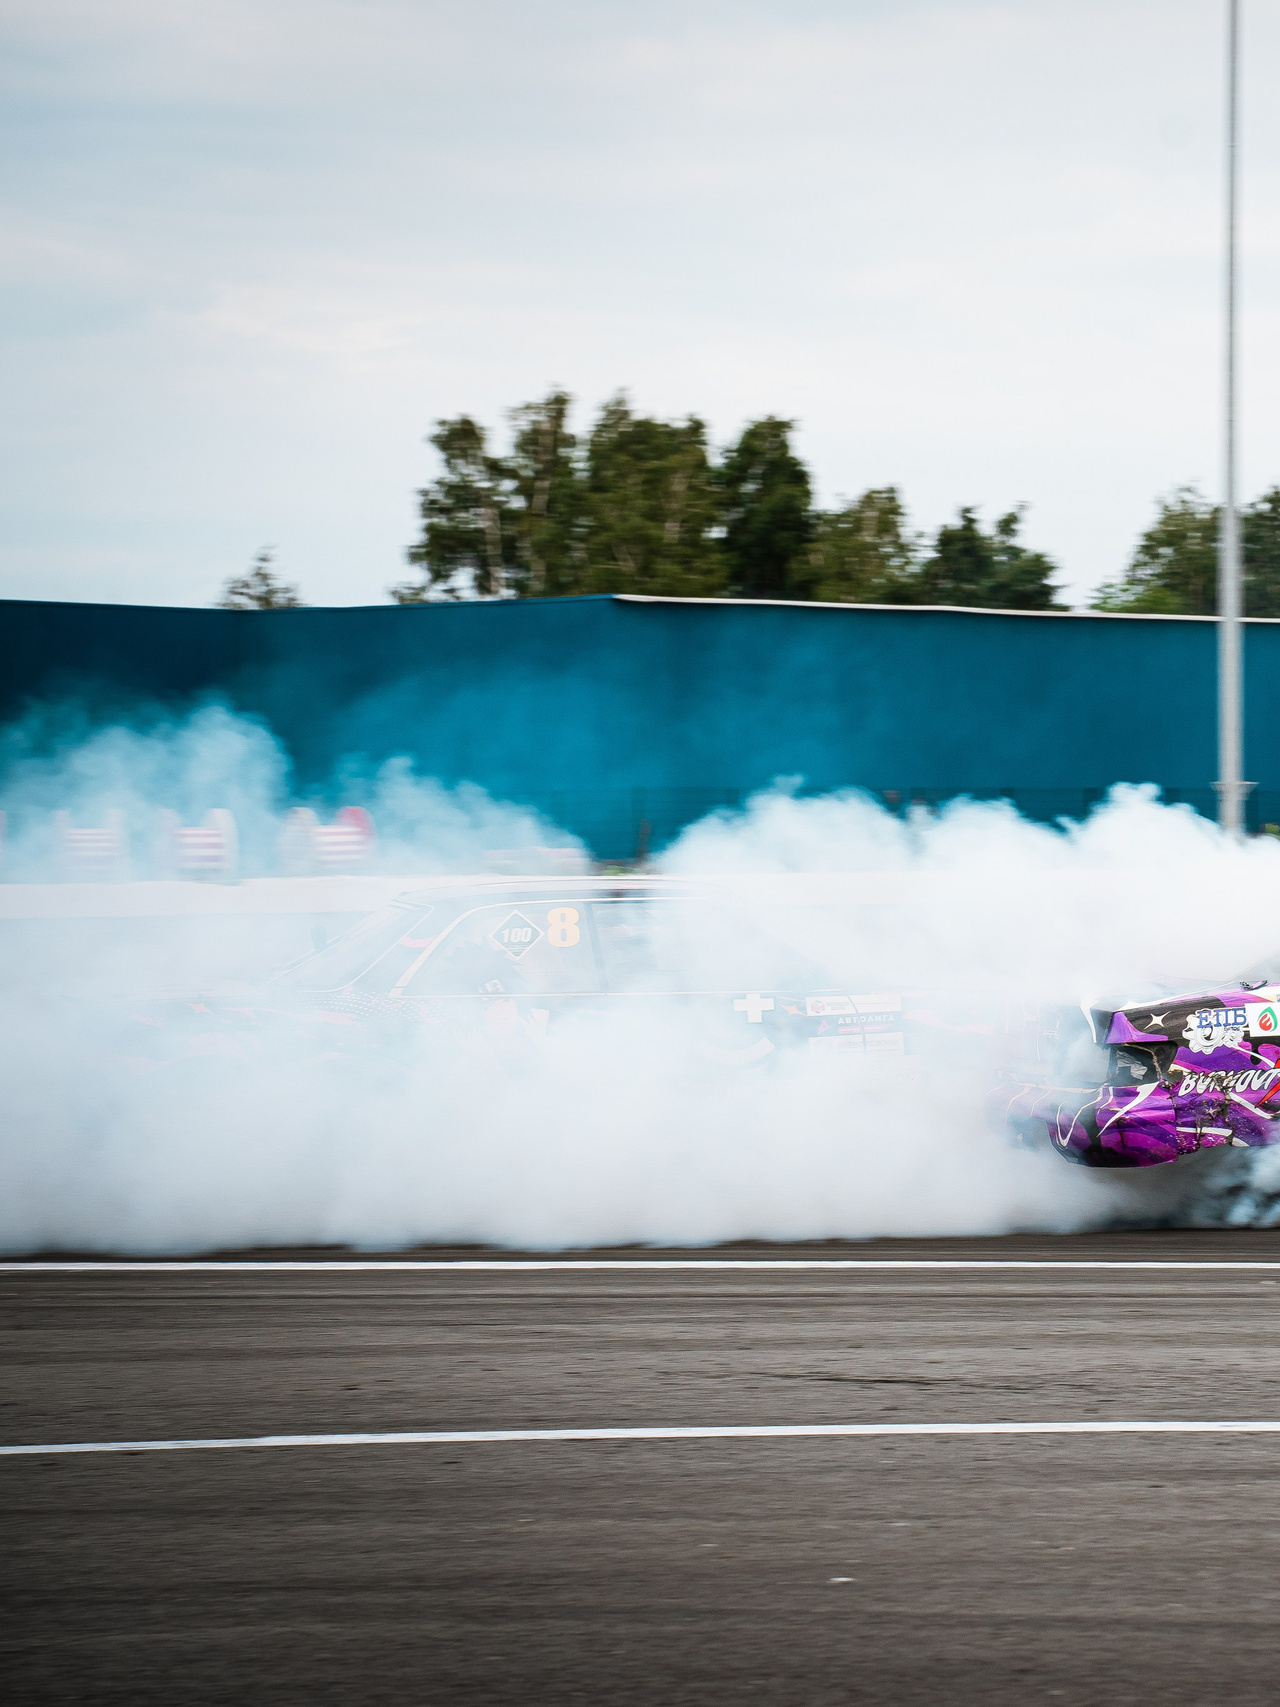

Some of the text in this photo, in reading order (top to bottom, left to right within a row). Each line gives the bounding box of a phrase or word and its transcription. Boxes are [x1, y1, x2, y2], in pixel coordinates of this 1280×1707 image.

[502, 927, 533, 943] 100
[547, 906, 580, 948] 8
[837, 1014, 895, 1024] АВТОЛИГА
